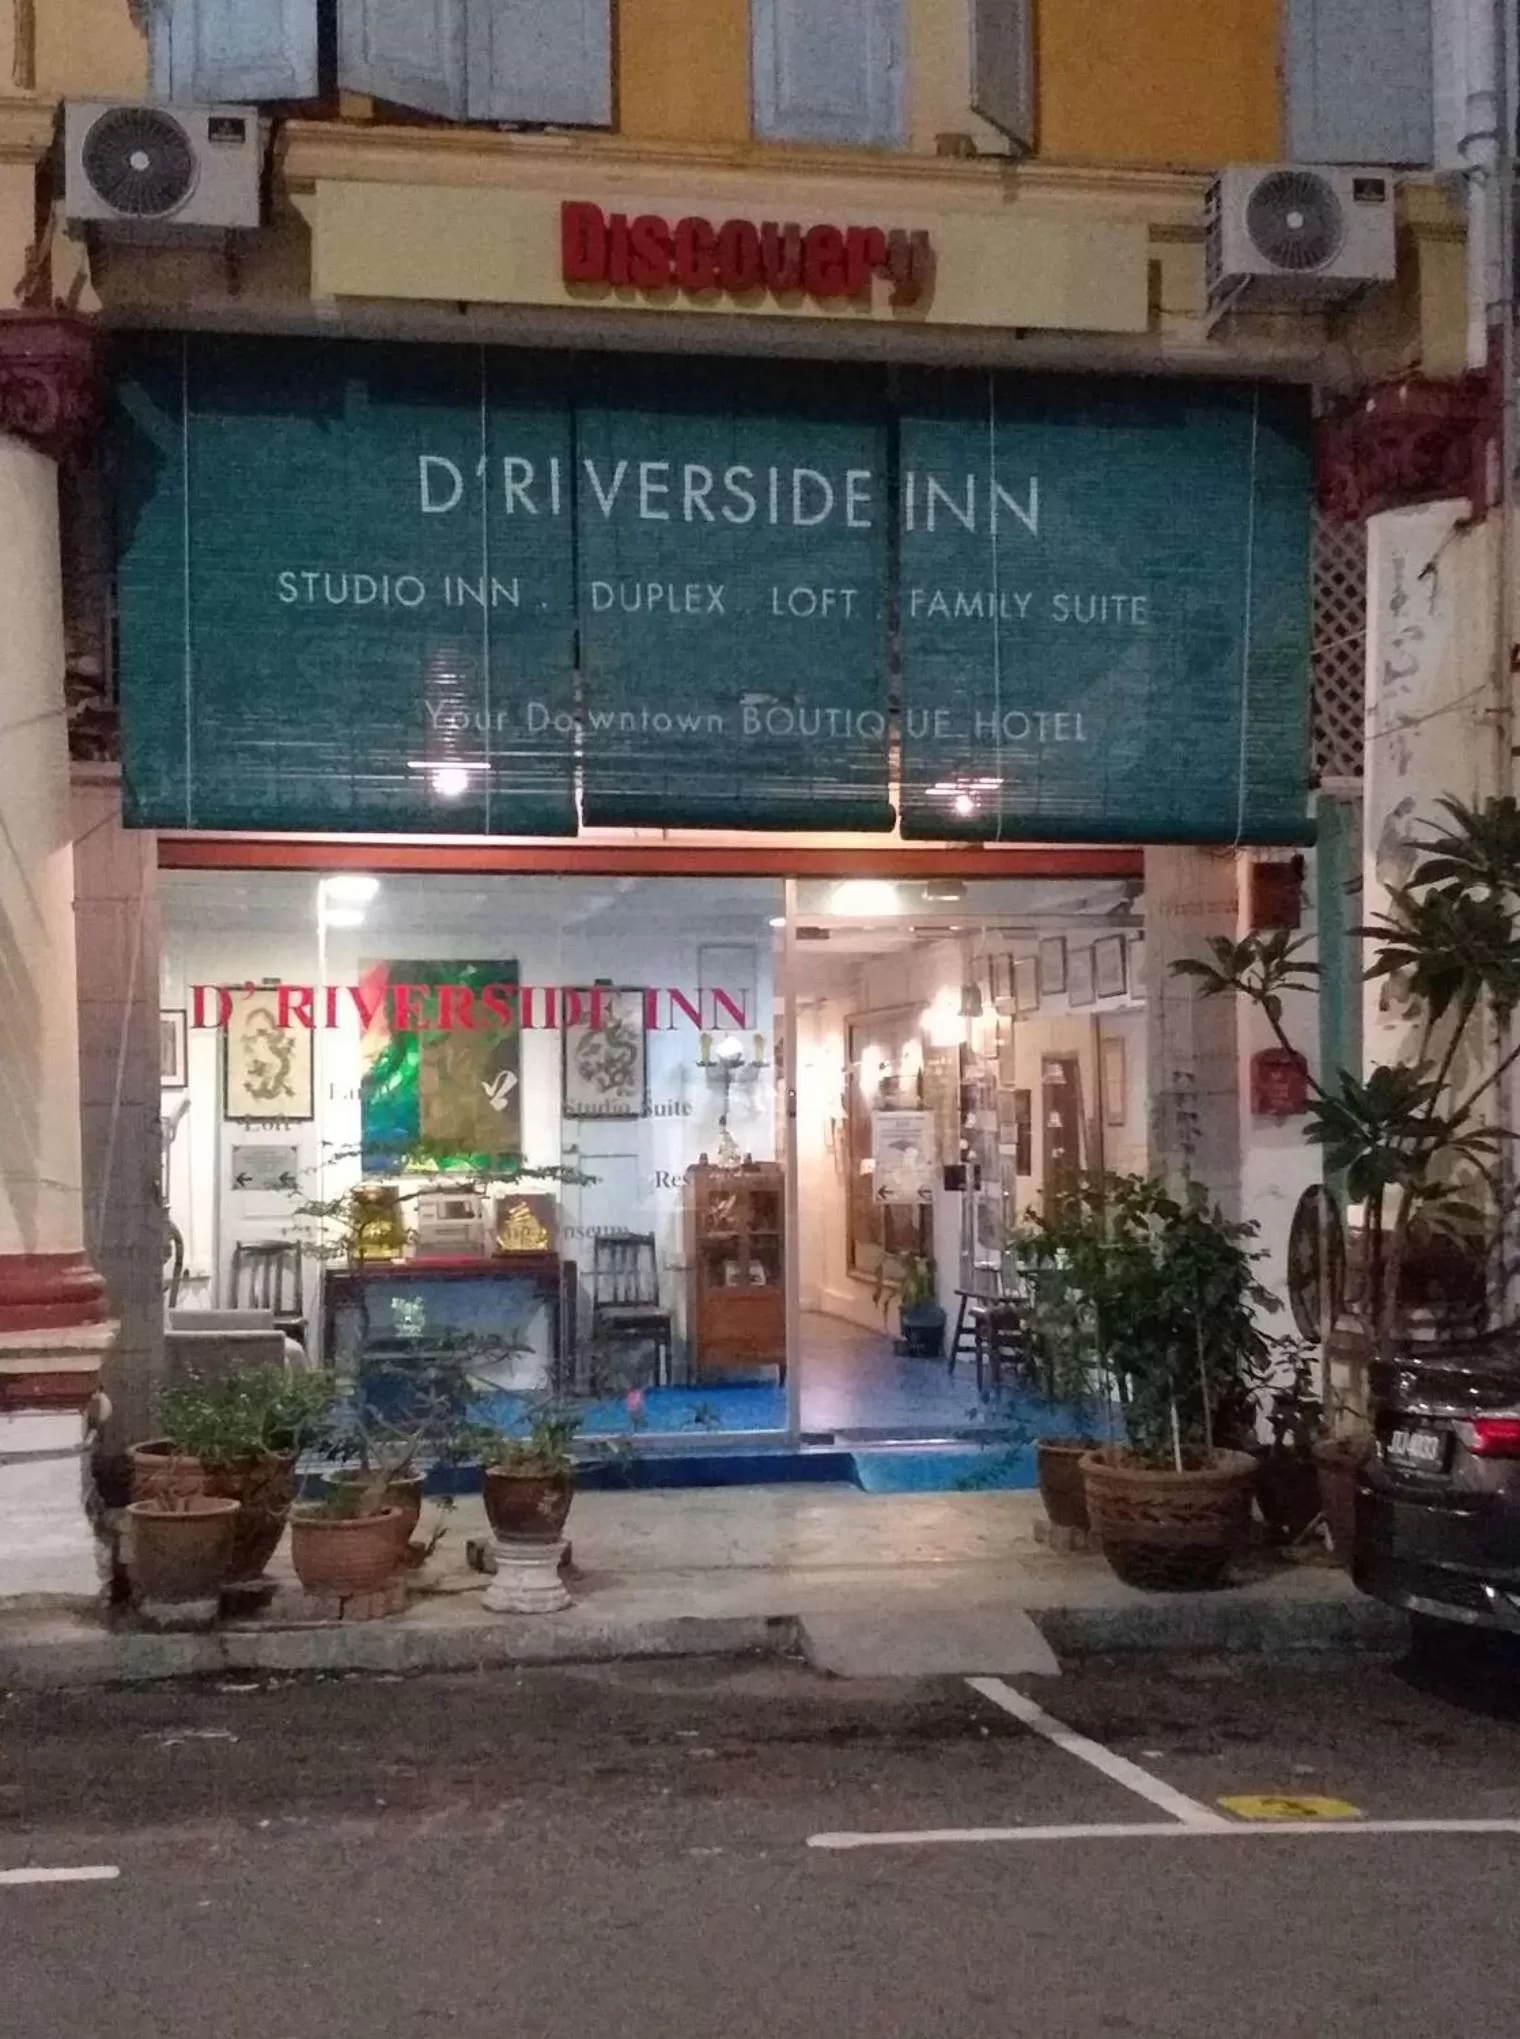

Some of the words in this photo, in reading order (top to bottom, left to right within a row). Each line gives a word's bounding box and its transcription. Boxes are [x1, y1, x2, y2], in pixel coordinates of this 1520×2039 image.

[419, 454, 872, 528] D'RIVERSIDE
[905, 470, 1039, 536] INN
[278, 571, 426, 606] STUDIO
[444, 575, 520, 608] INN
[591, 580, 726, 615] DUPLEX
[771, 586, 858, 618] LOFT
[910, 588, 1032, 619] FAMILY
[1051, 593, 1149, 625] SUITE
[424, 700, 508, 731] Your
[527, 702, 724, 733] Downtown
[743, 706, 954, 739] BOUTIQUE
[974, 710, 1087, 742] HOTEL
[641, 986, 751, 1031] INN
